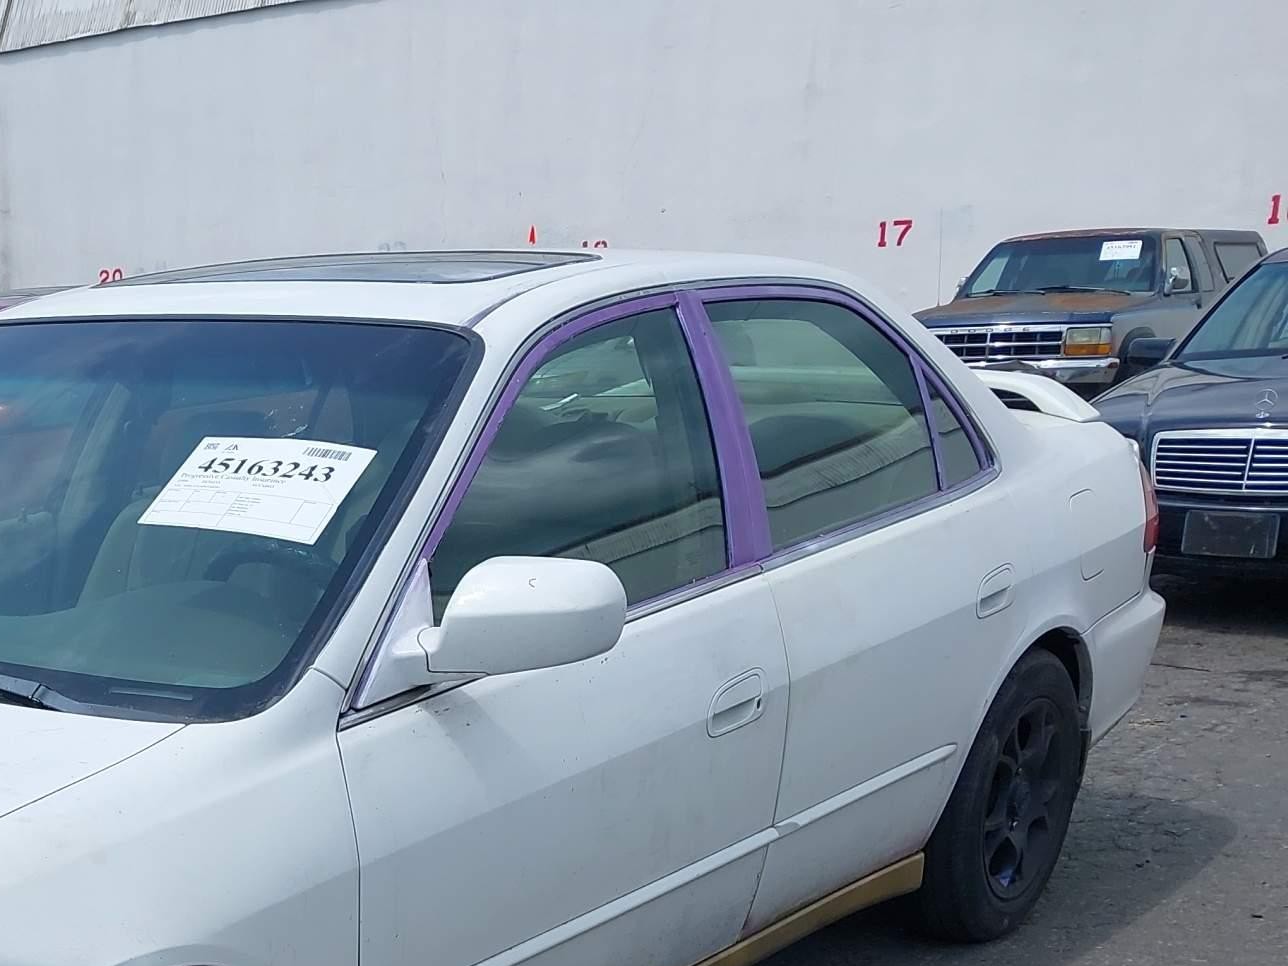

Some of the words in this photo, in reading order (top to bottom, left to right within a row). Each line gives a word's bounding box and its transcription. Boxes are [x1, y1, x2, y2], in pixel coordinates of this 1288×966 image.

[1268, 194, 1288, 224] 1
[877, 219, 913, 247] 17
[99, 268, 123, 284] 20
[950, 326, 1030, 334] DODGE
[198, 457, 335, 483] 45163243
